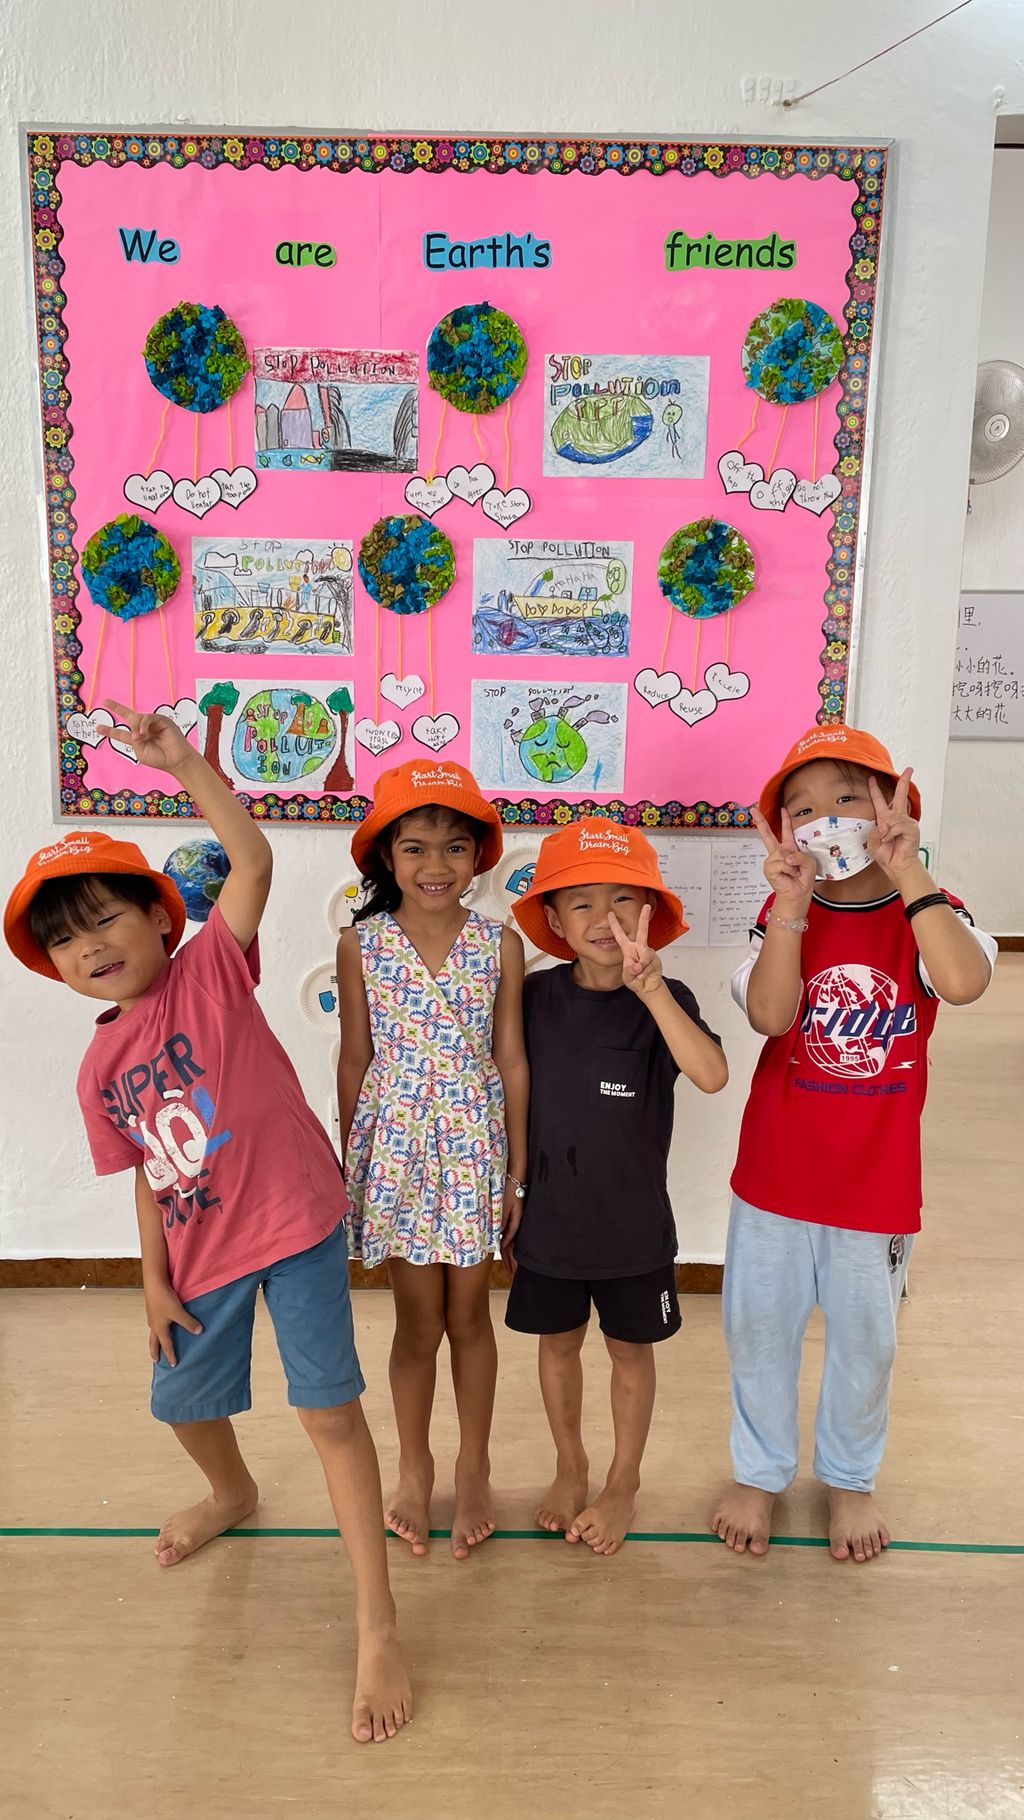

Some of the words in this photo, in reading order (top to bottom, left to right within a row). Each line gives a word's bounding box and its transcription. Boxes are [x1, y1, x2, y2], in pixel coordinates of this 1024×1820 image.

[118, 227, 179, 263] We
[274, 241, 335, 268] are
[426, 233, 550, 268] Earth's
[666, 231, 795, 268] friends
[264, 354, 298, 377] STOP
[549, 354, 592, 382] STOP
[186, 489, 195, 500] Do
[509, 540, 533, 556] STOP
[484, 686, 507, 698] STOP
[579, 828, 605, 841] Start
[604, 829, 629, 843] Small
[579, 840, 612, 851] Dream
[612, 841, 631, 856] Big
[600, 1081, 627, 1091] ENJOY
[611, 1090, 635, 1098] MOMENT
